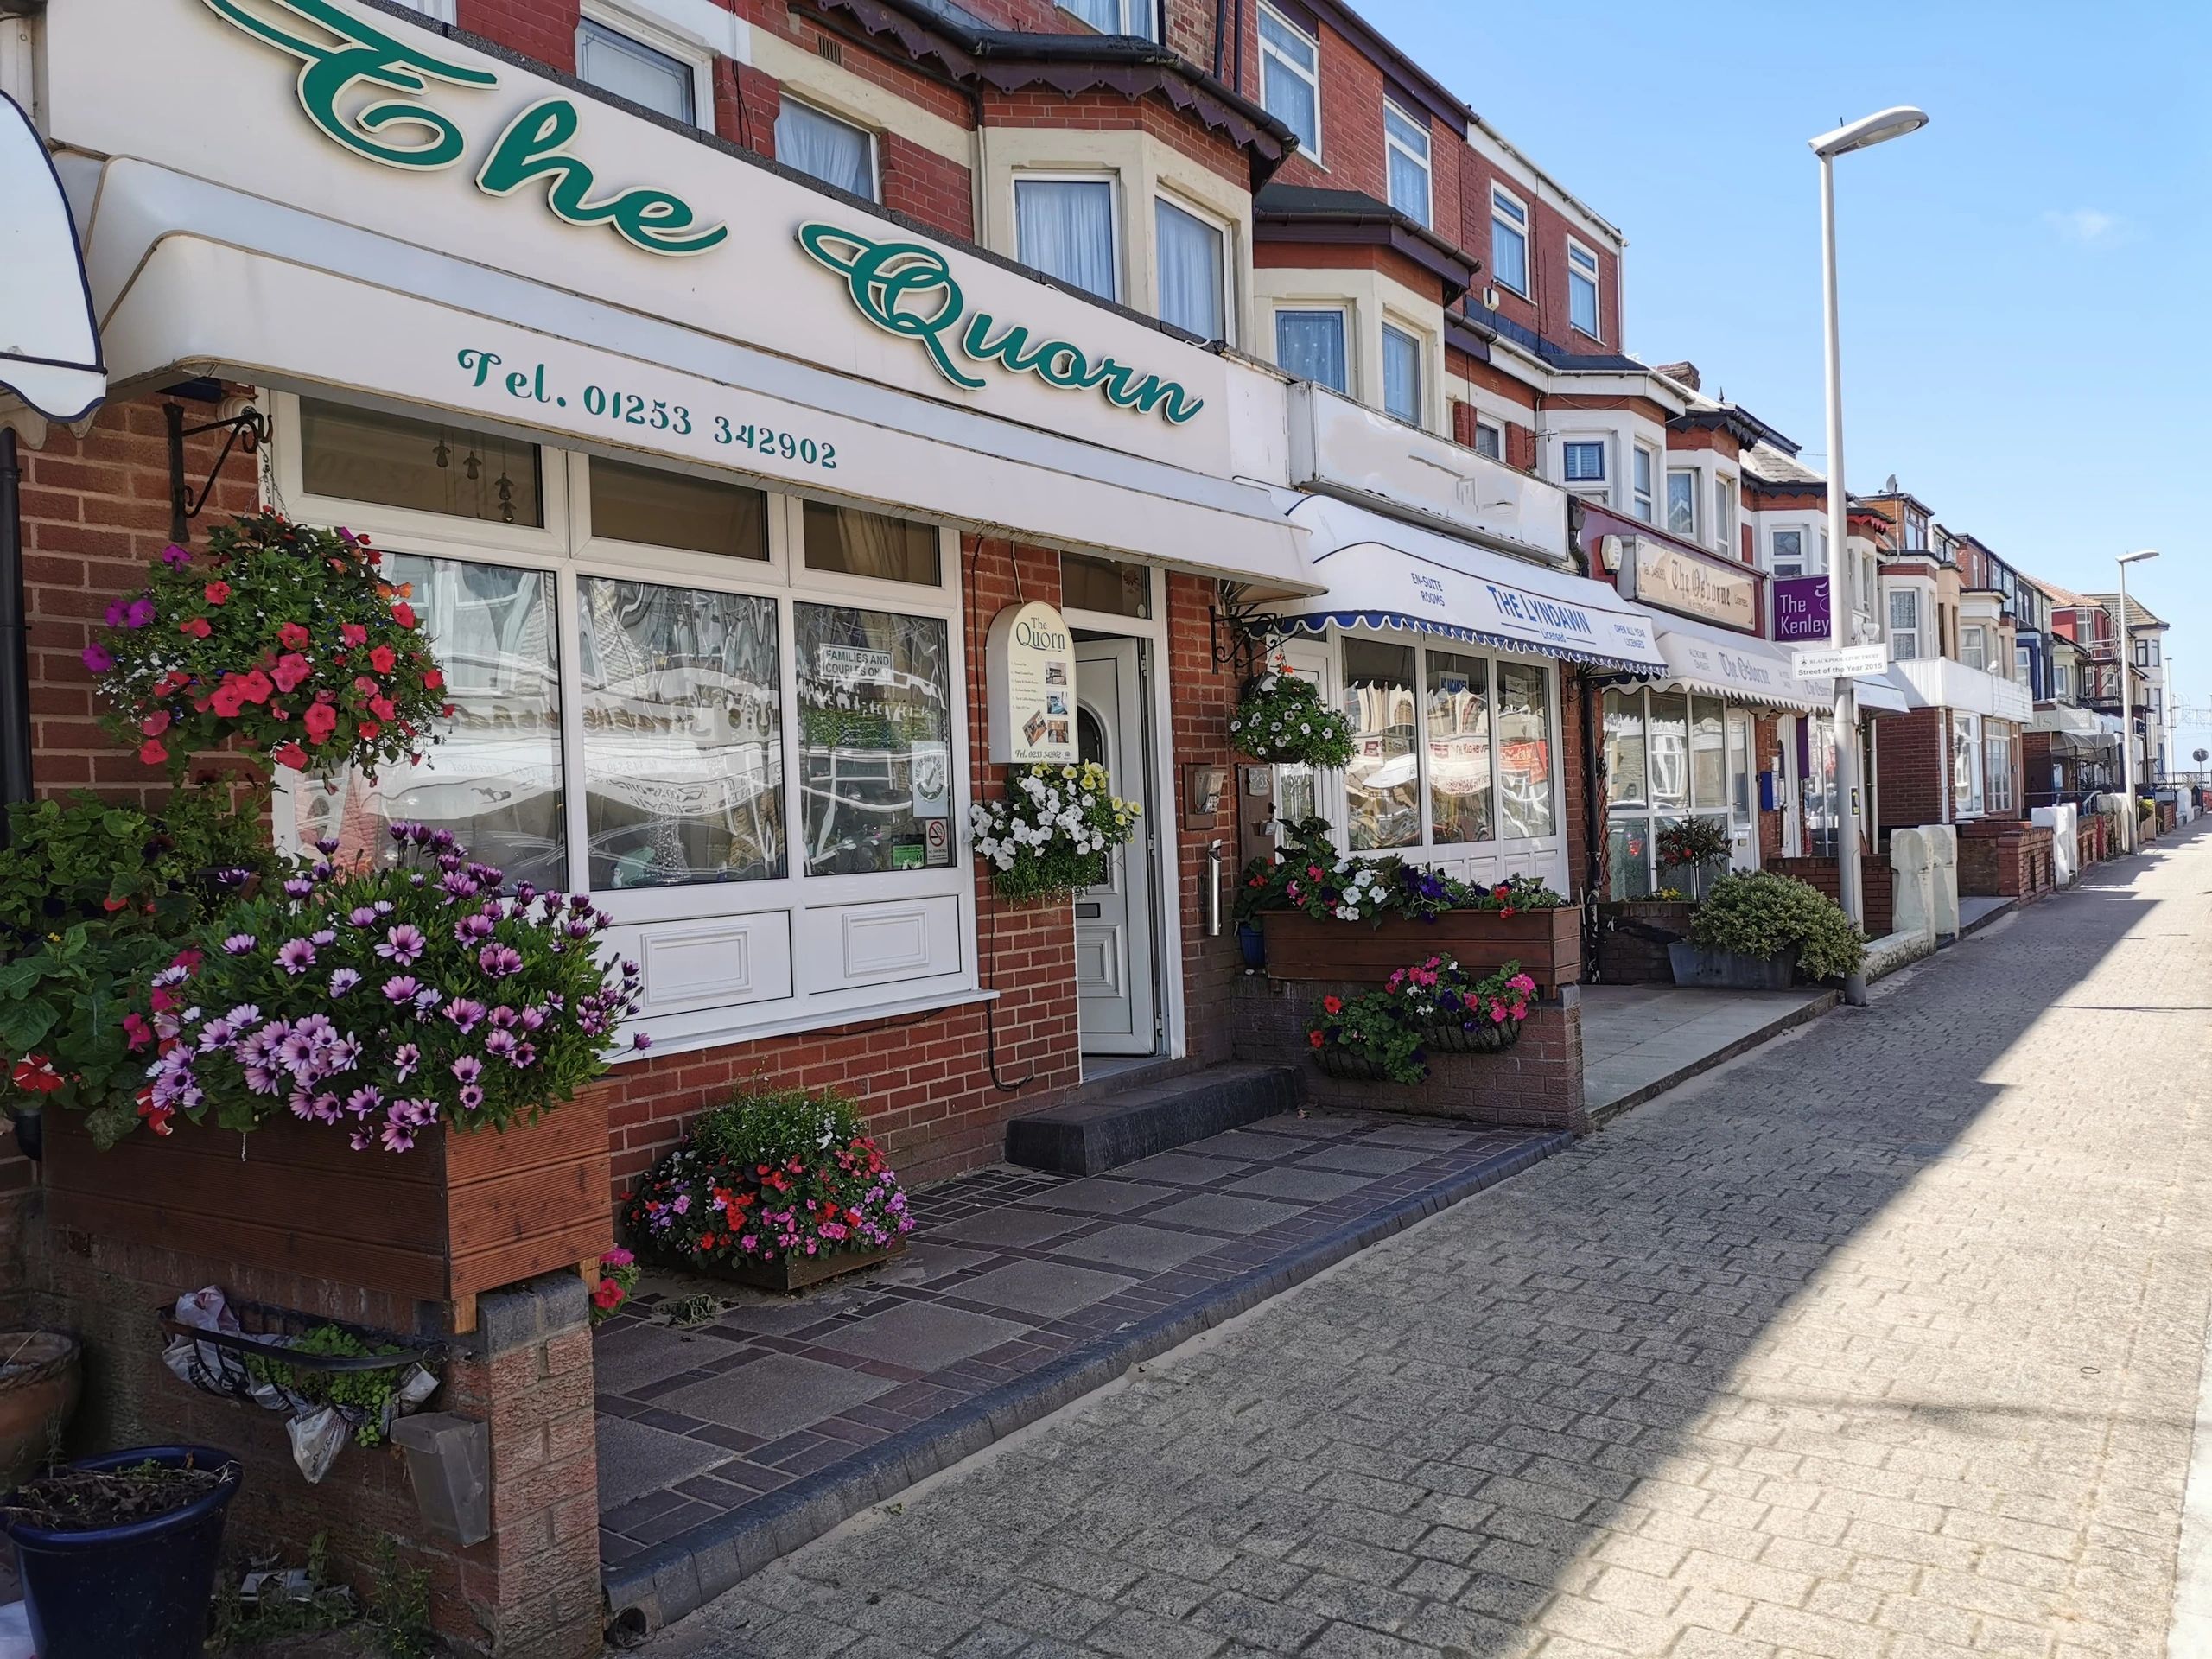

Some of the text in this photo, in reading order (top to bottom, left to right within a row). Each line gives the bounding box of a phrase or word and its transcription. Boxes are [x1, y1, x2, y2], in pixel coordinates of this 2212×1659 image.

[201, 0, 1205, 426] The Quorn
[457, 347, 837, 470] Tel. 01253 342902
[1411, 572, 1443, 592] EN-SUITE
[1671, 559, 1731, 607] The Osborne
[1420, 590, 1446, 607] ROOMS
[1780, 594, 1806, 613] The
[1486, 585, 1592, 634] THE LYNDAWN
[1030, 617, 1047, 630] The
[1781, 613, 1830, 636] Kenley
[1016, 622, 1066, 652] Quorn
[1539, 628, 1567, 643] Licensed
[826, 650, 889, 665] FAMILIES AND
[1865, 662, 1883, 671] 2015
